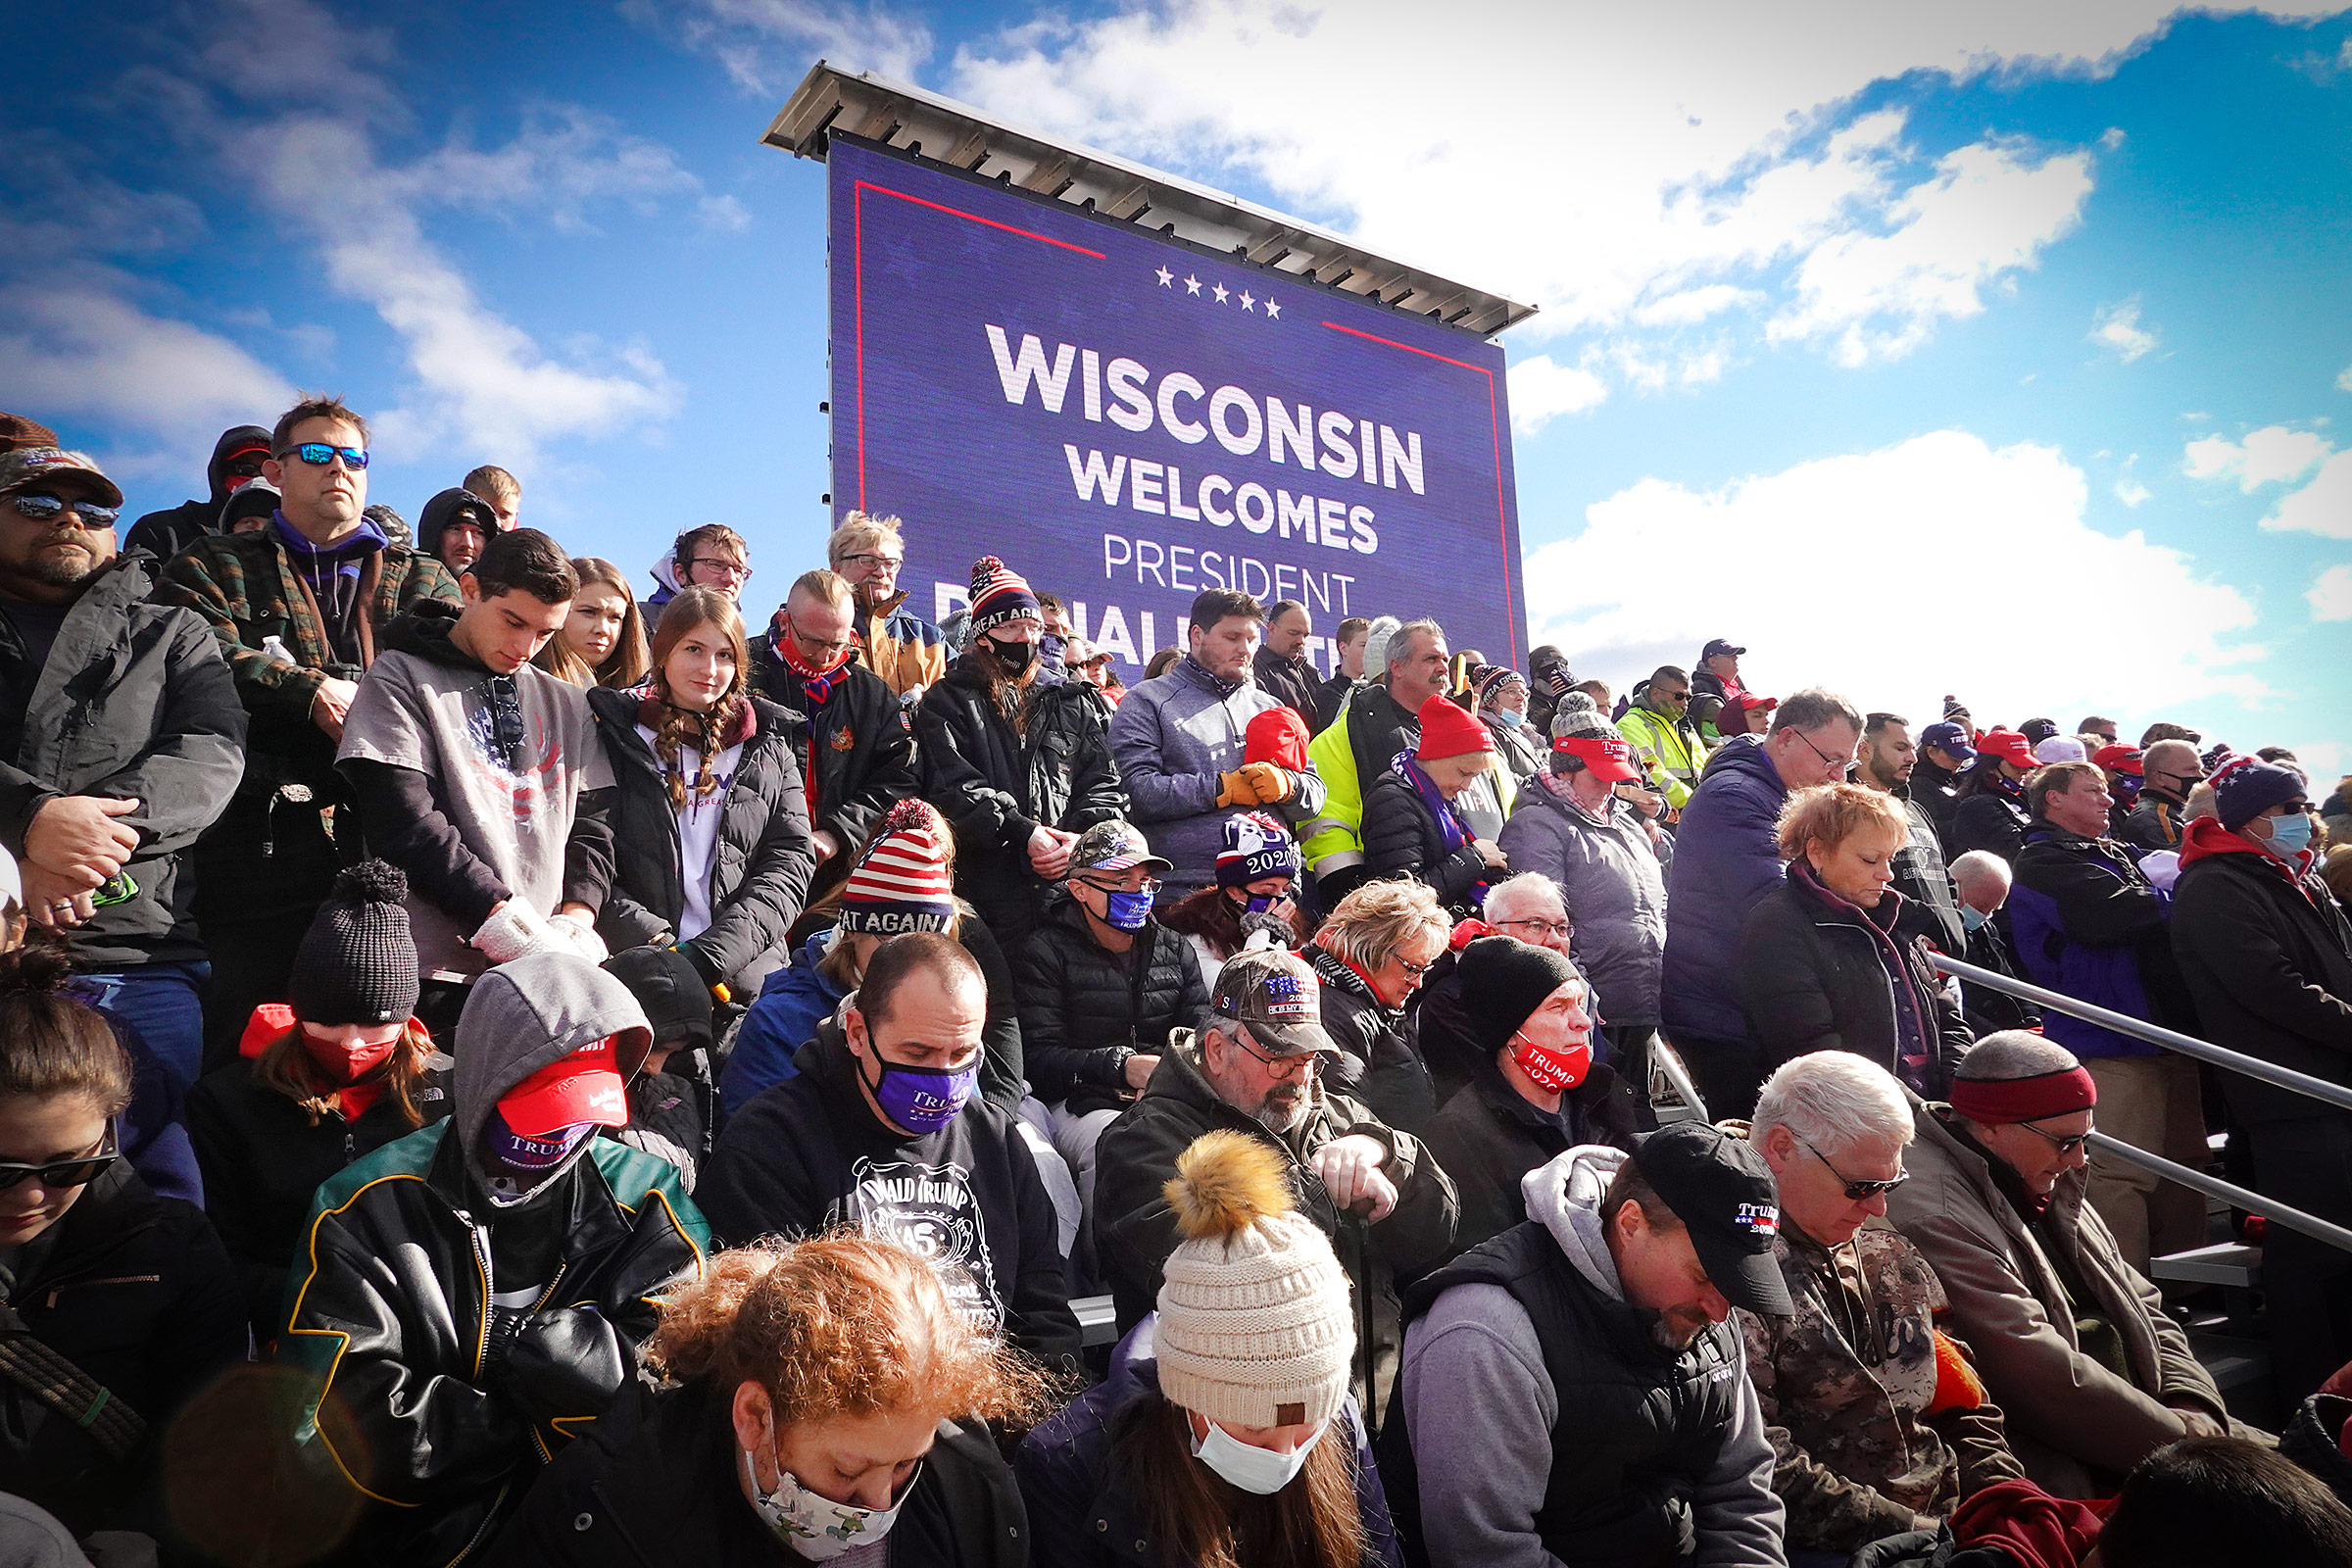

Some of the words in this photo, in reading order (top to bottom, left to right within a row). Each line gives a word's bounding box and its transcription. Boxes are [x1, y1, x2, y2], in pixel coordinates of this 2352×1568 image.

[985, 323, 1425, 495] WISCONSIN
[1063, 443, 1379, 555] WELCOMES
[1104, 534, 1355, 616] PRESIDENT
[972, 611, 1004, 638] GREAT
[1246, 850, 1293, 875] 2020
[864, 911, 941, 934] AGAIN
[1529, 1048, 1575, 1084] TRUMP
[912, 1086, 969, 1108] TRUMP
[510, 1130, 584, 1155] TRUMP
[918, 1175, 968, 1211] TRUMP
[1739, 1202, 1779, 1226] Trump
[903, 1223, 937, 1256] 45
